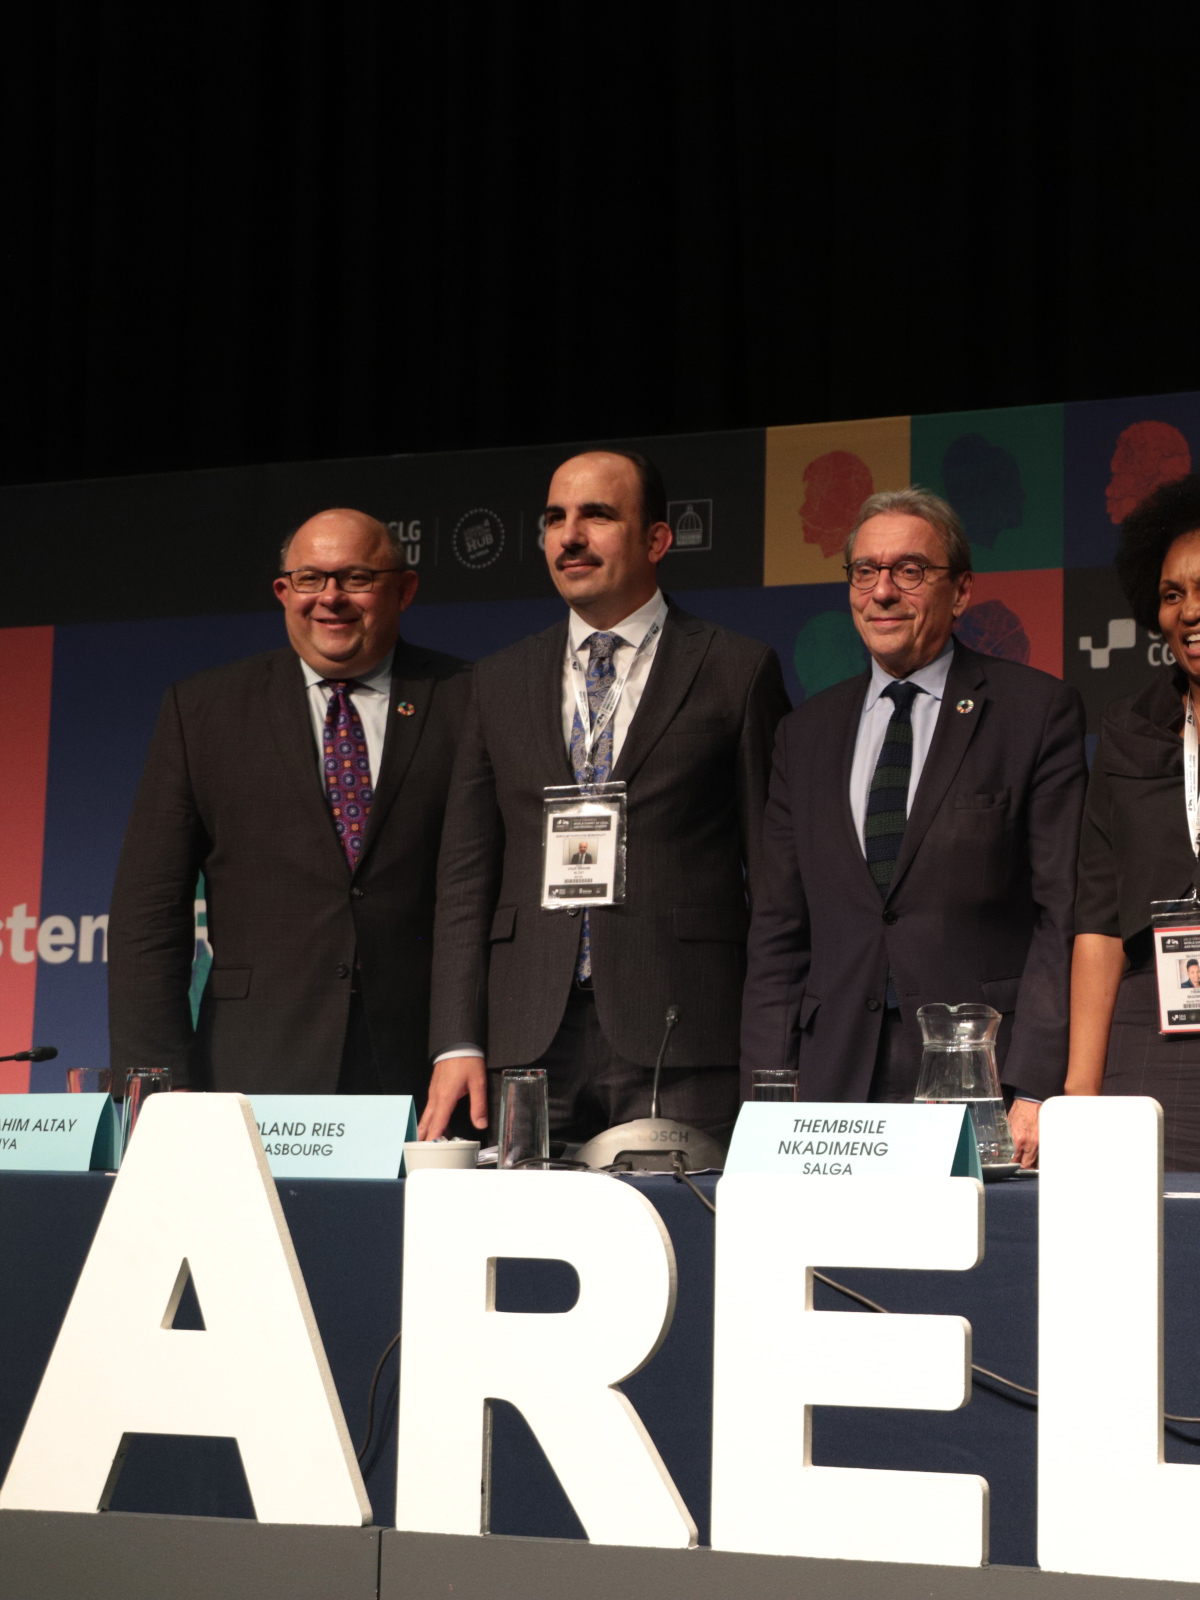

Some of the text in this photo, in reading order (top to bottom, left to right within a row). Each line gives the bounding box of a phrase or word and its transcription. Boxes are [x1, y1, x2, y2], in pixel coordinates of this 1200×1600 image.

[388, 520, 421, 541] LG
[0, 903, 108, 964] ten
[0, 1118, 78, 1132] HIM ALTAY
[311, 1123, 345, 1137] RIES
[793, 1119, 887, 1134] THEMBISILE
[0, 1138, 17, 1150] YA
[777, 1141, 889, 1156] NKADIMENG
[802, 1162, 853, 1175] SALGA
